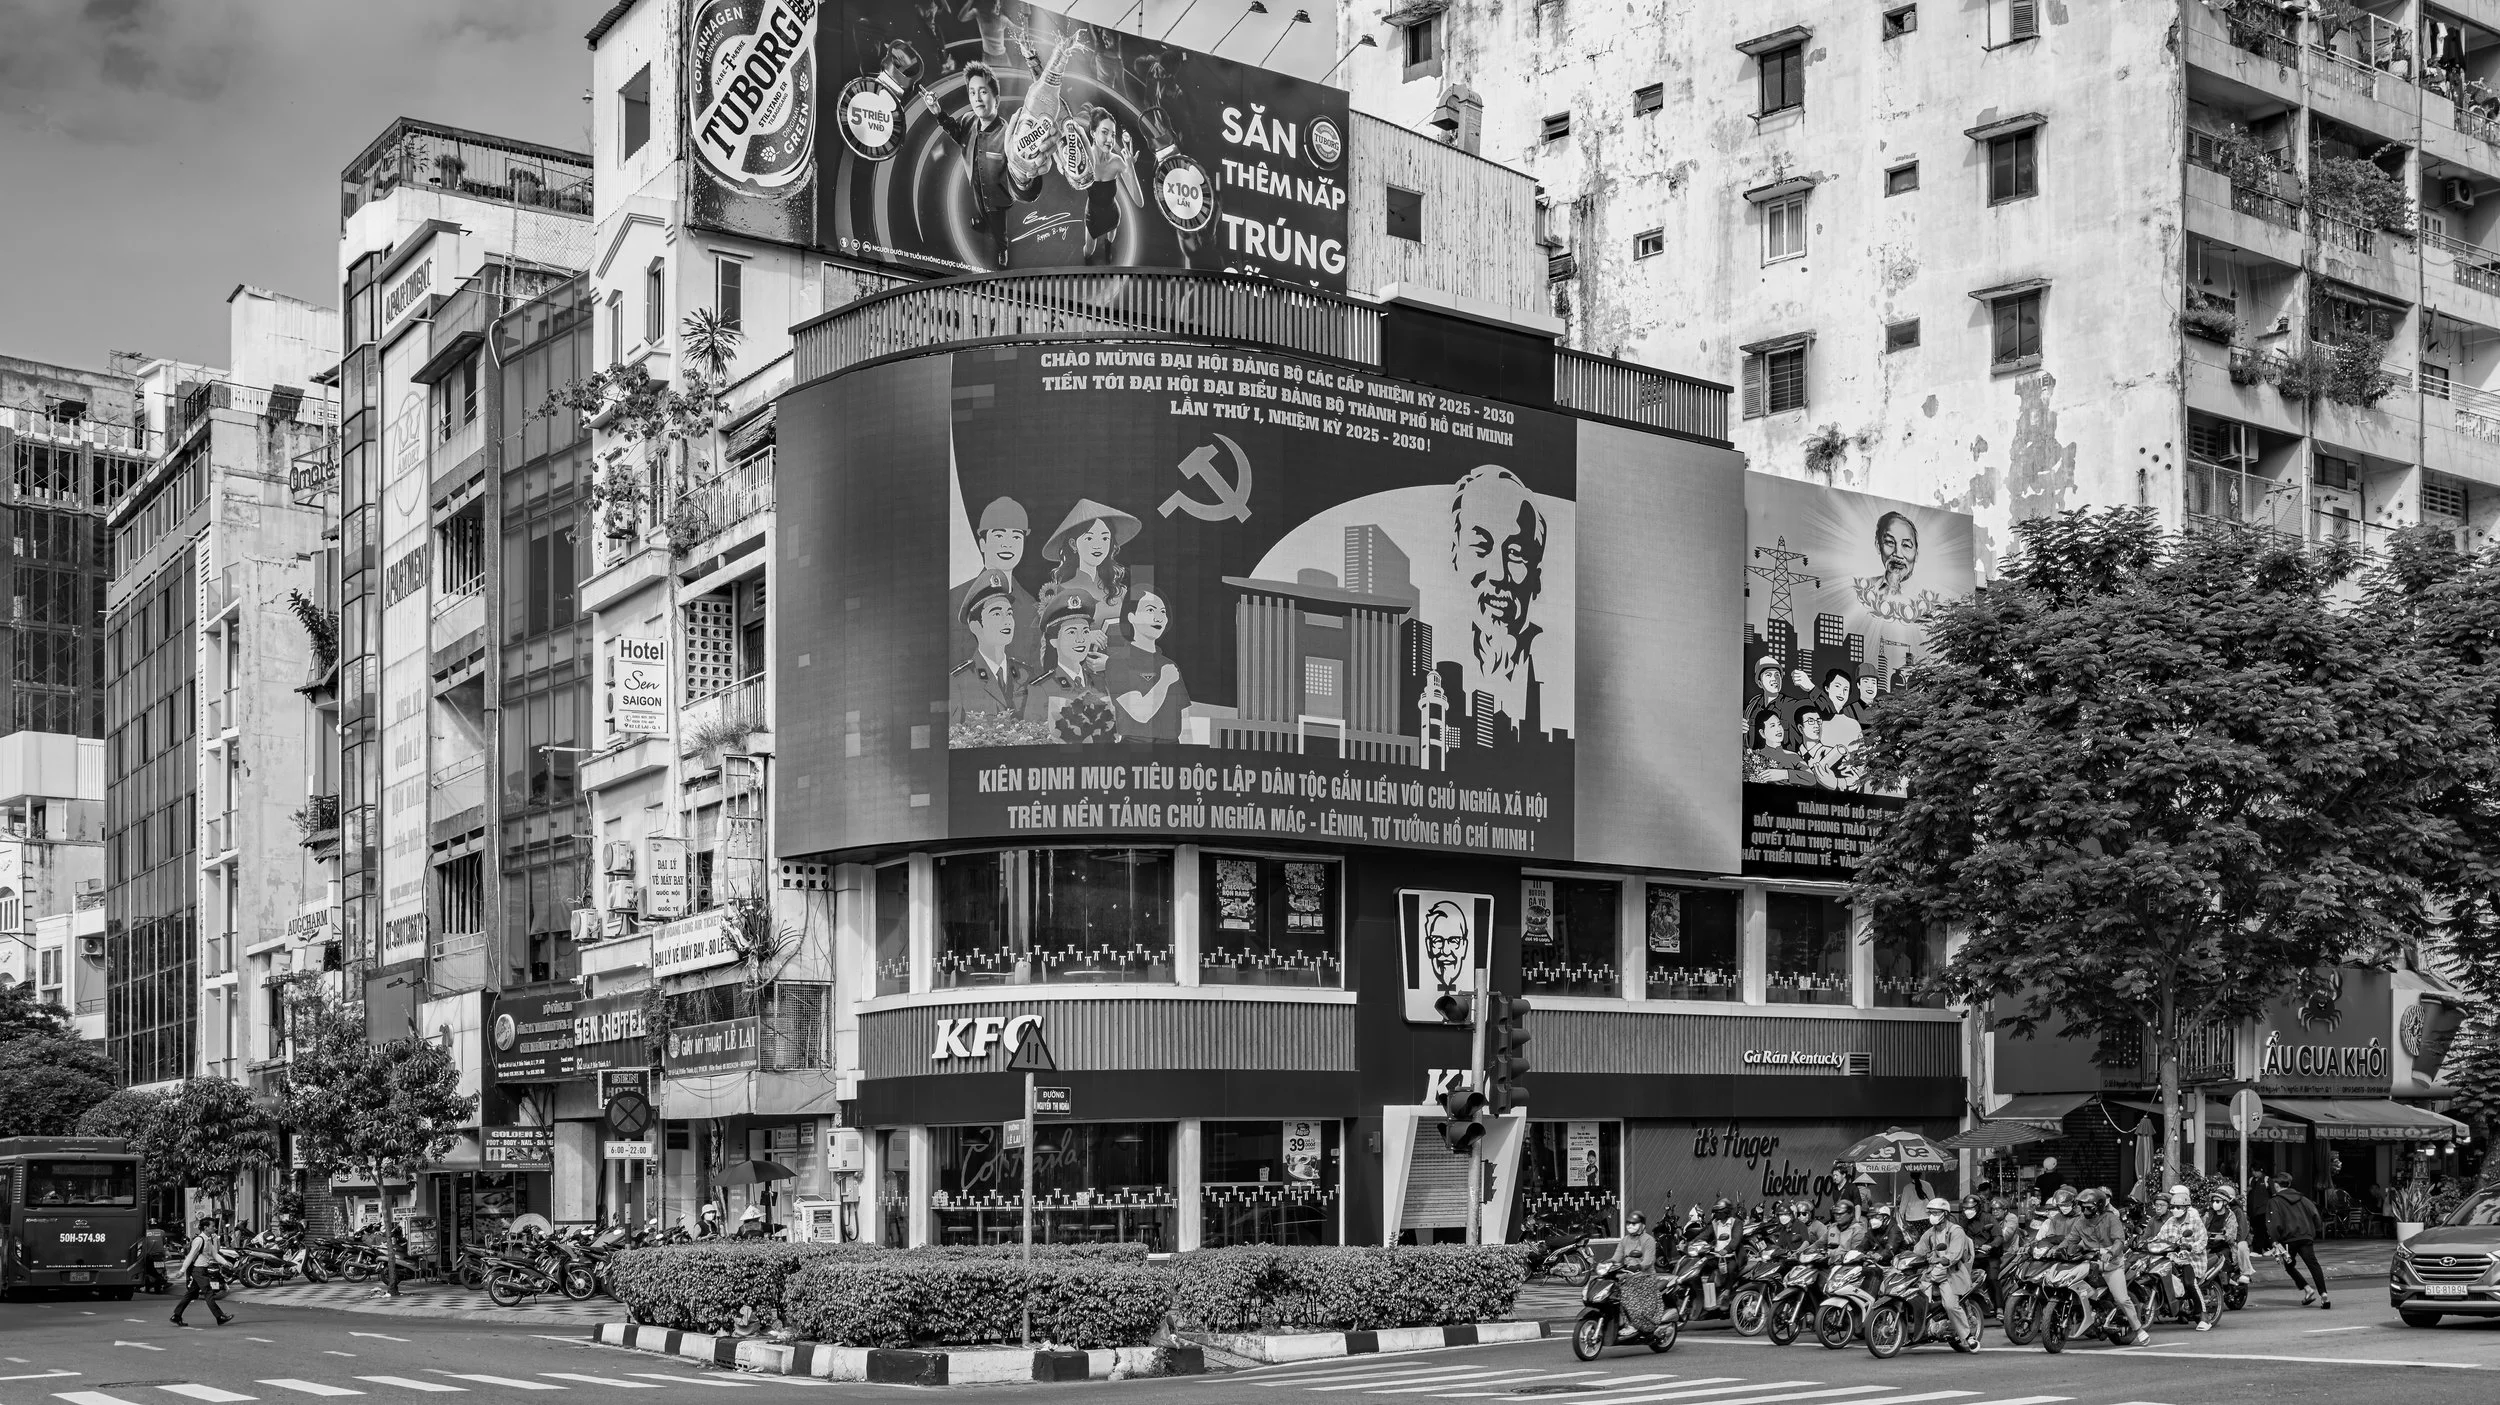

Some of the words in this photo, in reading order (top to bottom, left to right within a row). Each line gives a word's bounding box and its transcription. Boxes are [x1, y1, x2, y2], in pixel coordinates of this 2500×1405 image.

[693, 7, 743, 93] COPENHAGEN
[705, 30, 724, 63] DENMARK
[701, 5, 803, 160] TUBORG
[758, 91, 783, 128] STILSTAND
[780, 81, 788, 92] ER
[851, 107, 862, 125] 5
[862, 109, 890, 123] TRIỆU
[783, 106, 800, 138] ORIGINAL
[784, 103, 810, 154] GREEN
[868, 122, 884, 132] VNĐ
[1222, 102, 1296, 159] SĂN
[1029, 143, 1038, 152] ICE
[1314, 133, 1340, 150] TUBORG
[1222, 158, 1292, 199] THÊM
[1297, 175, 1345, 211] NẮP
[1222, 213, 1346, 274] TRÚNG
[386, 257, 432, 325] APARTMENT
[1041, 349, 1089, 367] CHÀO
[1095, 349, 1155, 367] MỪNG
[1160, 352, 1192, 370] ĐẠI
[1198, 353, 1228, 373] HỘI
[1233, 355, 1279, 378] ĐẢNG
[1284, 364, 1303, 384] BỘ
[1307, 369, 1333, 388] CÁC
[1337, 374, 1364, 394] CẤP
[1367, 382, 1414, 404] NHIỆM
[1418, 390, 1436, 408] KỲ
[1439, 398, 1470, 416] 2025
[1483, 406, 1515, 425] 2030
[1042, 371, 1087, 391] TIẾN
[1092, 372, 1125, 390] TỚI
[1129, 375, 1162, 392] ĐẠI
[1167, 375, 1198, 394] HỘI
[1203, 378, 1234, 396] ĐẠI
[1239, 379, 1277, 400] BIỂU
[1281, 387, 1322, 408] ĐẢNG
[1326, 396, 1345, 416] BỘ
[1348, 401, 1397, 423] THÀNH
[1400, 411, 1428, 429] PHỐ
[1431, 414, 1449, 433] HỒ
[1452, 422, 1473, 439] CHÍ
[1476, 427, 1513, 446] MINH
[1170, 395, 1208, 416] LẦN
[1213, 403, 1250, 420] THỨ
[1254, 407, 1264, 424] I,
[1268, 408, 1319, 431] NHIỆM
[1323, 418, 1342, 435] KỲ
[1346, 423, 1379, 442] 2025
[621, 640, 663, 660] Hotel
[624, 670, 660, 690] Sen
[622, 695, 662, 706] SAIGON
[979, 764, 1022, 793] KIÊN
[1028, 767, 1075, 796] ĐỊNH
[1081, 766, 1126, 794] MỤC
[1132, 762, 1174, 790] TIÊU
[1179, 763, 1217, 796] ĐỘC
[1223, 764, 1256, 797] LẬP
[1262, 767, 1295, 795] DÂN
[1299, 770, 1326, 802] TỘC
[1331, 770, 1362, 801] GẮN
[1366, 775, 1397, 805] LIỀN
[1401, 780, 1424, 808] VỚI
[1428, 781, 1455, 810] CHỦ
[1459, 787, 1501, 814] NGHĨA
[1504, 790, 1522, 816] XÃ
[1526, 792, 1547, 822] HỘI
[1797, 801, 1829, 815] THÀNH
[1831, 803, 1850, 817] PHỐ
[1852, 804, 1865, 819] HỒ
[1008, 800, 1057, 829] TRÊN
[1063, 796, 1103, 827] NỀN
[1109, 796, 1161, 827] TẢNG
[1167, 797, 1205, 828] CHỦ
[1211, 802, 1266, 830] NGHĨA
[1271, 805, 1305, 833] MÁC
[1320, 808, 1368, 841] LÊNIN,
[1372, 816, 1391, 840] TƯ
[1393, 813, 1439, 844] TƯỞNG
[1443, 817, 1461, 846] HỒ
[1466, 823, 1488, 848] CHÍ
[1492, 827, 1527, 850] MINH
[1753, 812, 1774, 827] ĐẨY
[1776, 816, 1806, 831] MẠNH
[1808, 819, 1840, 834] PHONG
[1842, 821, 1866, 836] TRÀO
[1751, 830, 1783, 846] QUYẾT
[1785, 832, 1806, 847] TÂM
[1808, 837, 1832, 850] THỰC
[1834, 838, 1857, 852] HIỆN
[657, 859, 667, 871] ĐẠI
[670, 858, 677, 869] LÝ
[1742, 848, 1761, 861] HÁT
[1763, 847, 1792, 863] TRIỂN
[1794, 852, 1818, 865] KINH
[1820, 851, 1832, 866] TẾ
[660, 873, 672, 886] MÁY
[673, 876, 684, 886] BAY
[288, 909, 327, 936] AUGCHARM
[681, 940, 692, 961] MÁY
[694, 941, 705, 959] BAY
[574, 1016, 599, 1046] SEN
[601, 1009, 647, 1042] HOTEL
[705, 1032, 722, 1055] THUẬT
[724, 1022, 737, 1050] LÊ
[739, 1027, 755, 1048] LAI
[576, 1057, 583, 1070] 82
[1744, 1050, 1761, 1063] Gà
[1763, 1050, 1788, 1064] Rán
[1790, 1051, 1844, 1068] Kentucky
[2259, 1030, 2294, 1076] ẨU
[2297, 1045, 2339, 1076] CUA
[2341, 1038, 2388, 1077] KHÔI
[612, 1073, 639, 1084] SEN
[1043, 1090, 1064, 1098] ĐƯỜNG
[2358, 1128, 2369, 1137] CUA
[630, 1146, 647, 1155] 22:00
[1289, 1138, 1305, 1151] 39
[1693, 1127, 1718, 1158] it's
[1722, 1120, 1780, 1170] finger
[1762, 1159, 1811, 1197] lickin'
[1913, 1163, 1927, 1171] MÁY
[60, 1233, 106, 1242] 50H-574.98
